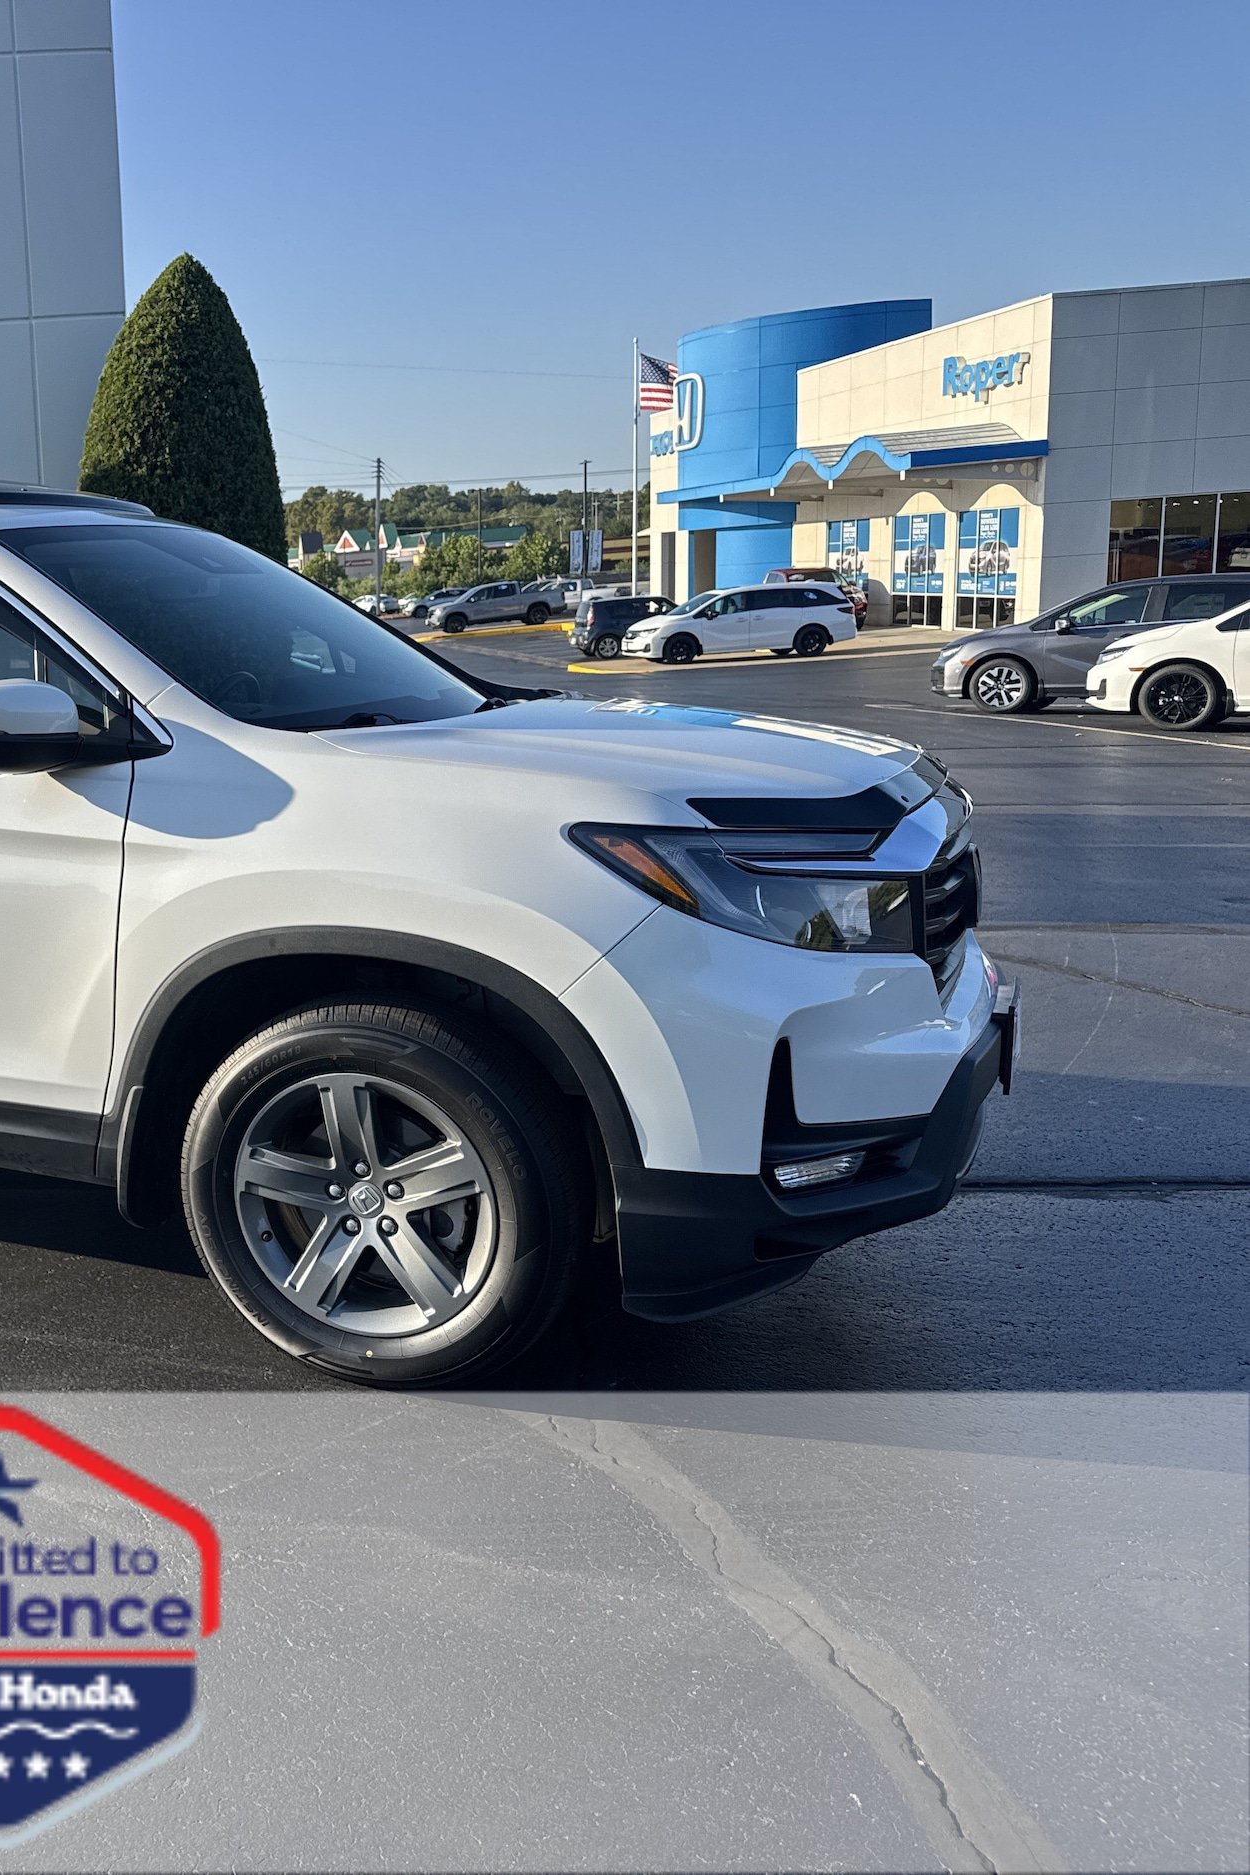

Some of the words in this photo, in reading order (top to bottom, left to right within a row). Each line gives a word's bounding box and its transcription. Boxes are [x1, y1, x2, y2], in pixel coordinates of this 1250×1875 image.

[942, 352, 1029, 404] Roper
[240, 1044, 302, 1086] 245/60R18
[465, 1091, 527, 1181] ROVELO
